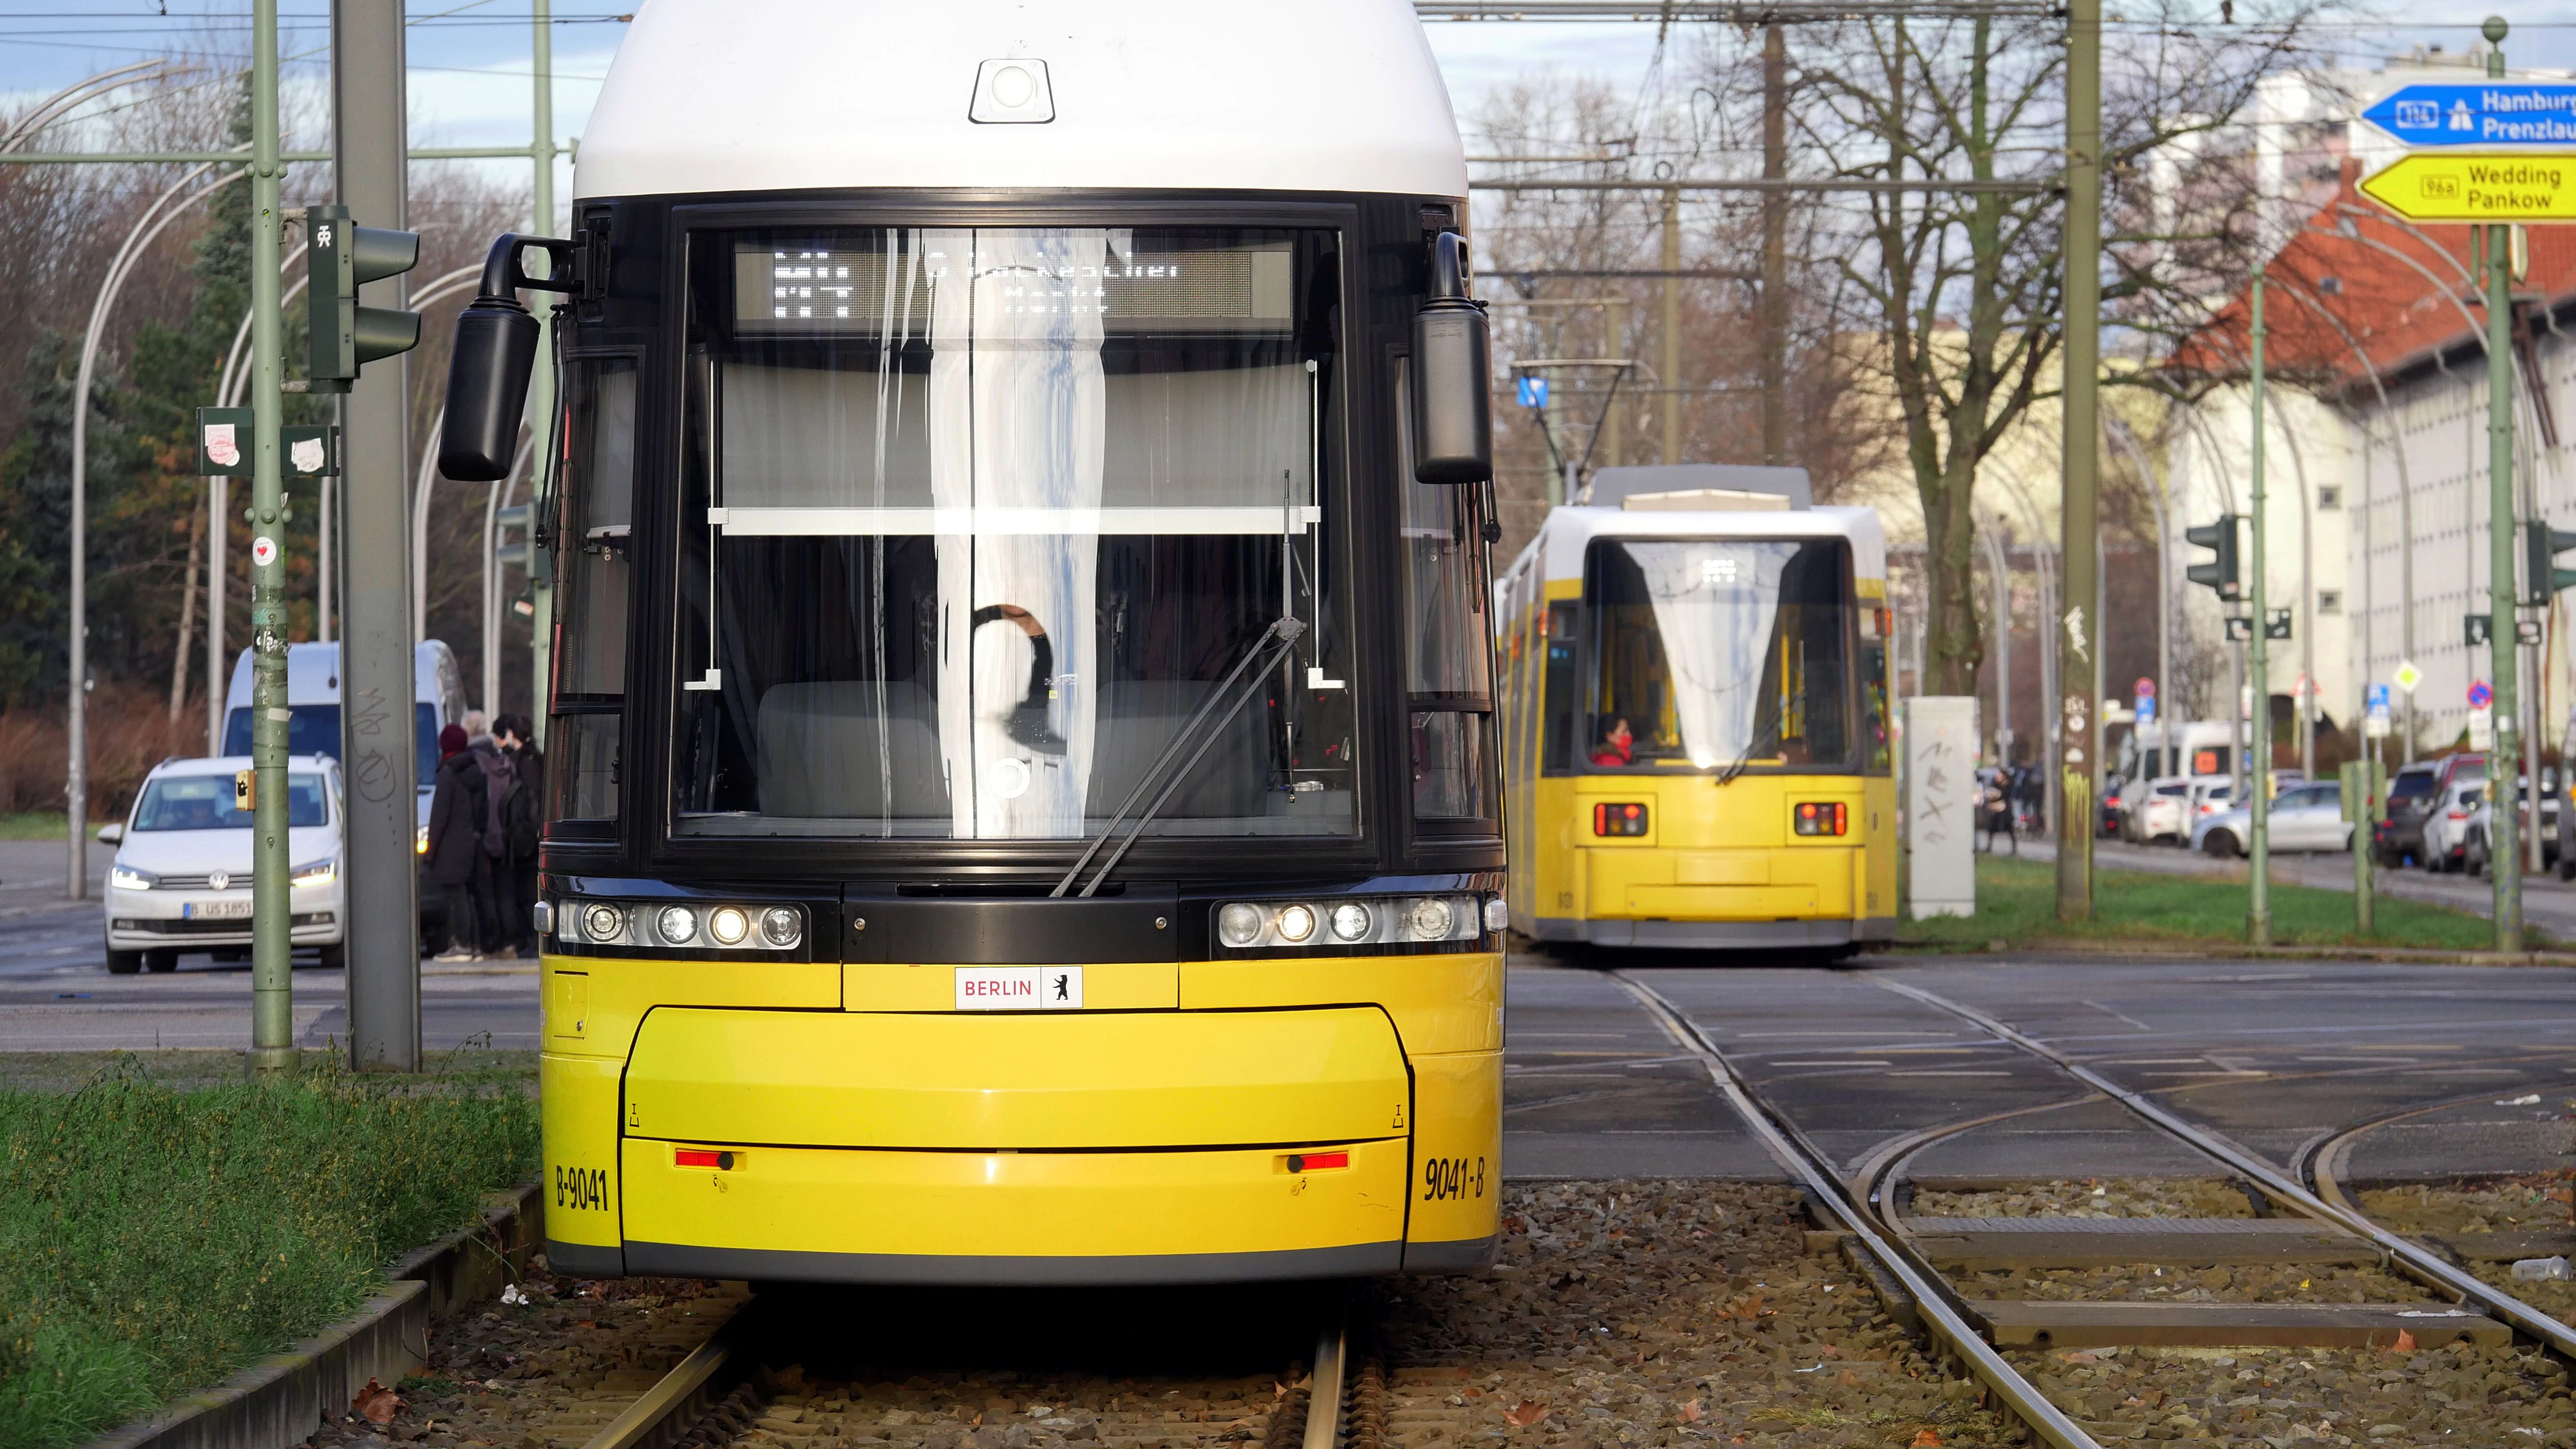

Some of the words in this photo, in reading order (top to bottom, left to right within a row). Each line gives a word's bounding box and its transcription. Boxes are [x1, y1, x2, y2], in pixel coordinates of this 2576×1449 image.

[2483, 117, 2576, 140] Prenzlau
[2469, 164, 2561, 190] Wedding
[2469, 189, 2552, 209] Pankow
[965, 981, 1031, 996] BERLIN
[556, 1165, 608, 1211] B-9041
[1424, 1157, 1485, 1201] 9041-B
